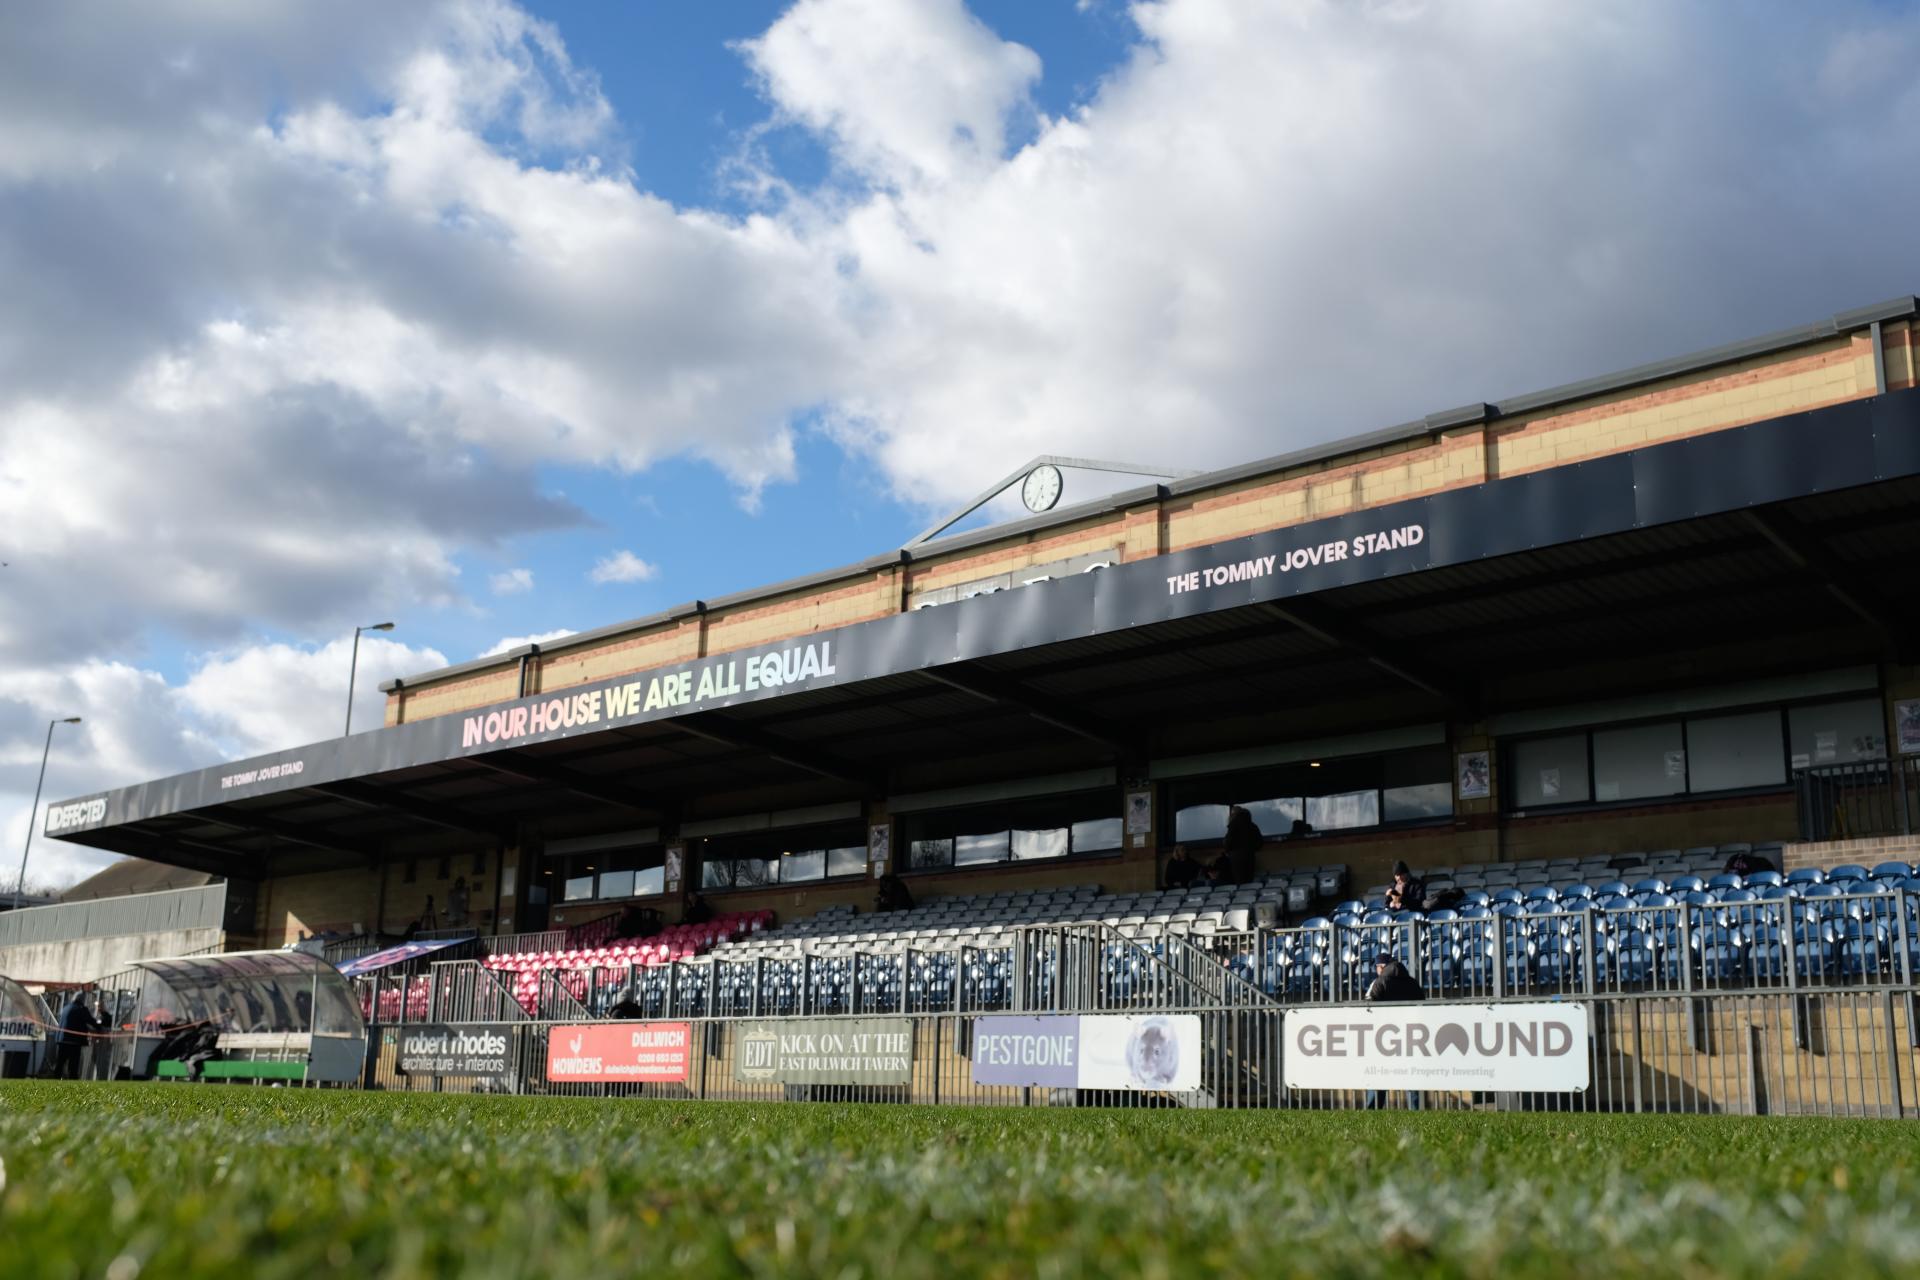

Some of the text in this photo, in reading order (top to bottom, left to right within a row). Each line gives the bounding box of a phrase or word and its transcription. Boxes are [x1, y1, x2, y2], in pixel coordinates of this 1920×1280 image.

[1167, 525, 1424, 595] THE TOMMY JOVER STAND
[462, 641, 836, 748] IN OUR HOUSE WE ARE ALL EQUAL
[257, 764, 281, 781] JOVER
[280, 760, 304, 776] STAND
[46, 797, 107, 832] DEFECTED
[404, 1030, 506, 1055] robert rhodes
[631, 1031, 685, 1048] DULWICH
[780, 1032, 909, 1054] KICK ON AT THE
[976, 1034, 1074, 1066] PESTGONE
[1297, 1021, 1573, 1057] GETGROUND
[402, 1055, 505, 1072] architecture + interiors
[745, 1041, 775, 1067] EDT
[779, 1057, 908, 1071] EAST DULWICH TAVERN
[552, 1057, 603, 1075] HOWDENS
[1364, 1066, 1495, 1077] All-in-one Property Investing
